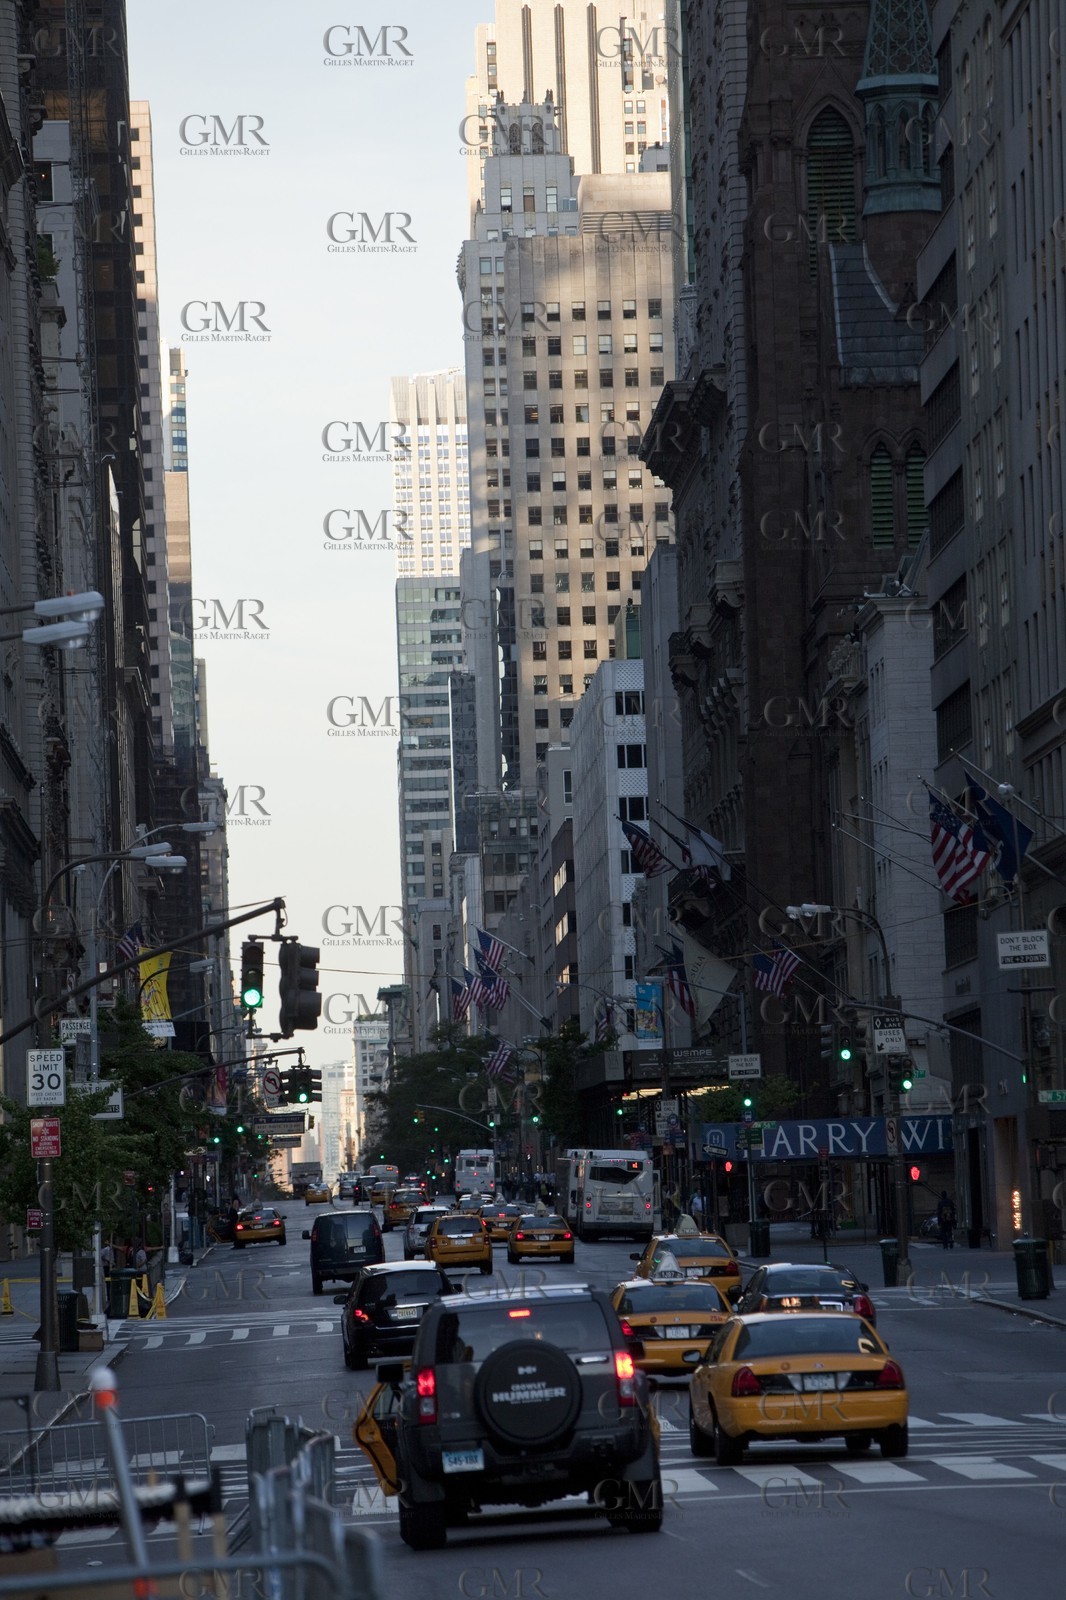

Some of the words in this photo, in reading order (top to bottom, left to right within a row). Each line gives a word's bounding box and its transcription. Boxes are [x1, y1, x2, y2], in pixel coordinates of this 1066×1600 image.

[1022, 935, 1045, 943] BLOCK
[1024, 943, 1037, 951] BOX
[62, 1022, 91, 1030] PASSENGE
[673, 1048, 713, 1058] WEMPE
[30, 1054, 62, 1062] SPEED
[33, 1064, 59, 1072] LIMIT
[31, 1073, 61, 1090] 30
[492, 1387, 567, 1403] HUMMER
